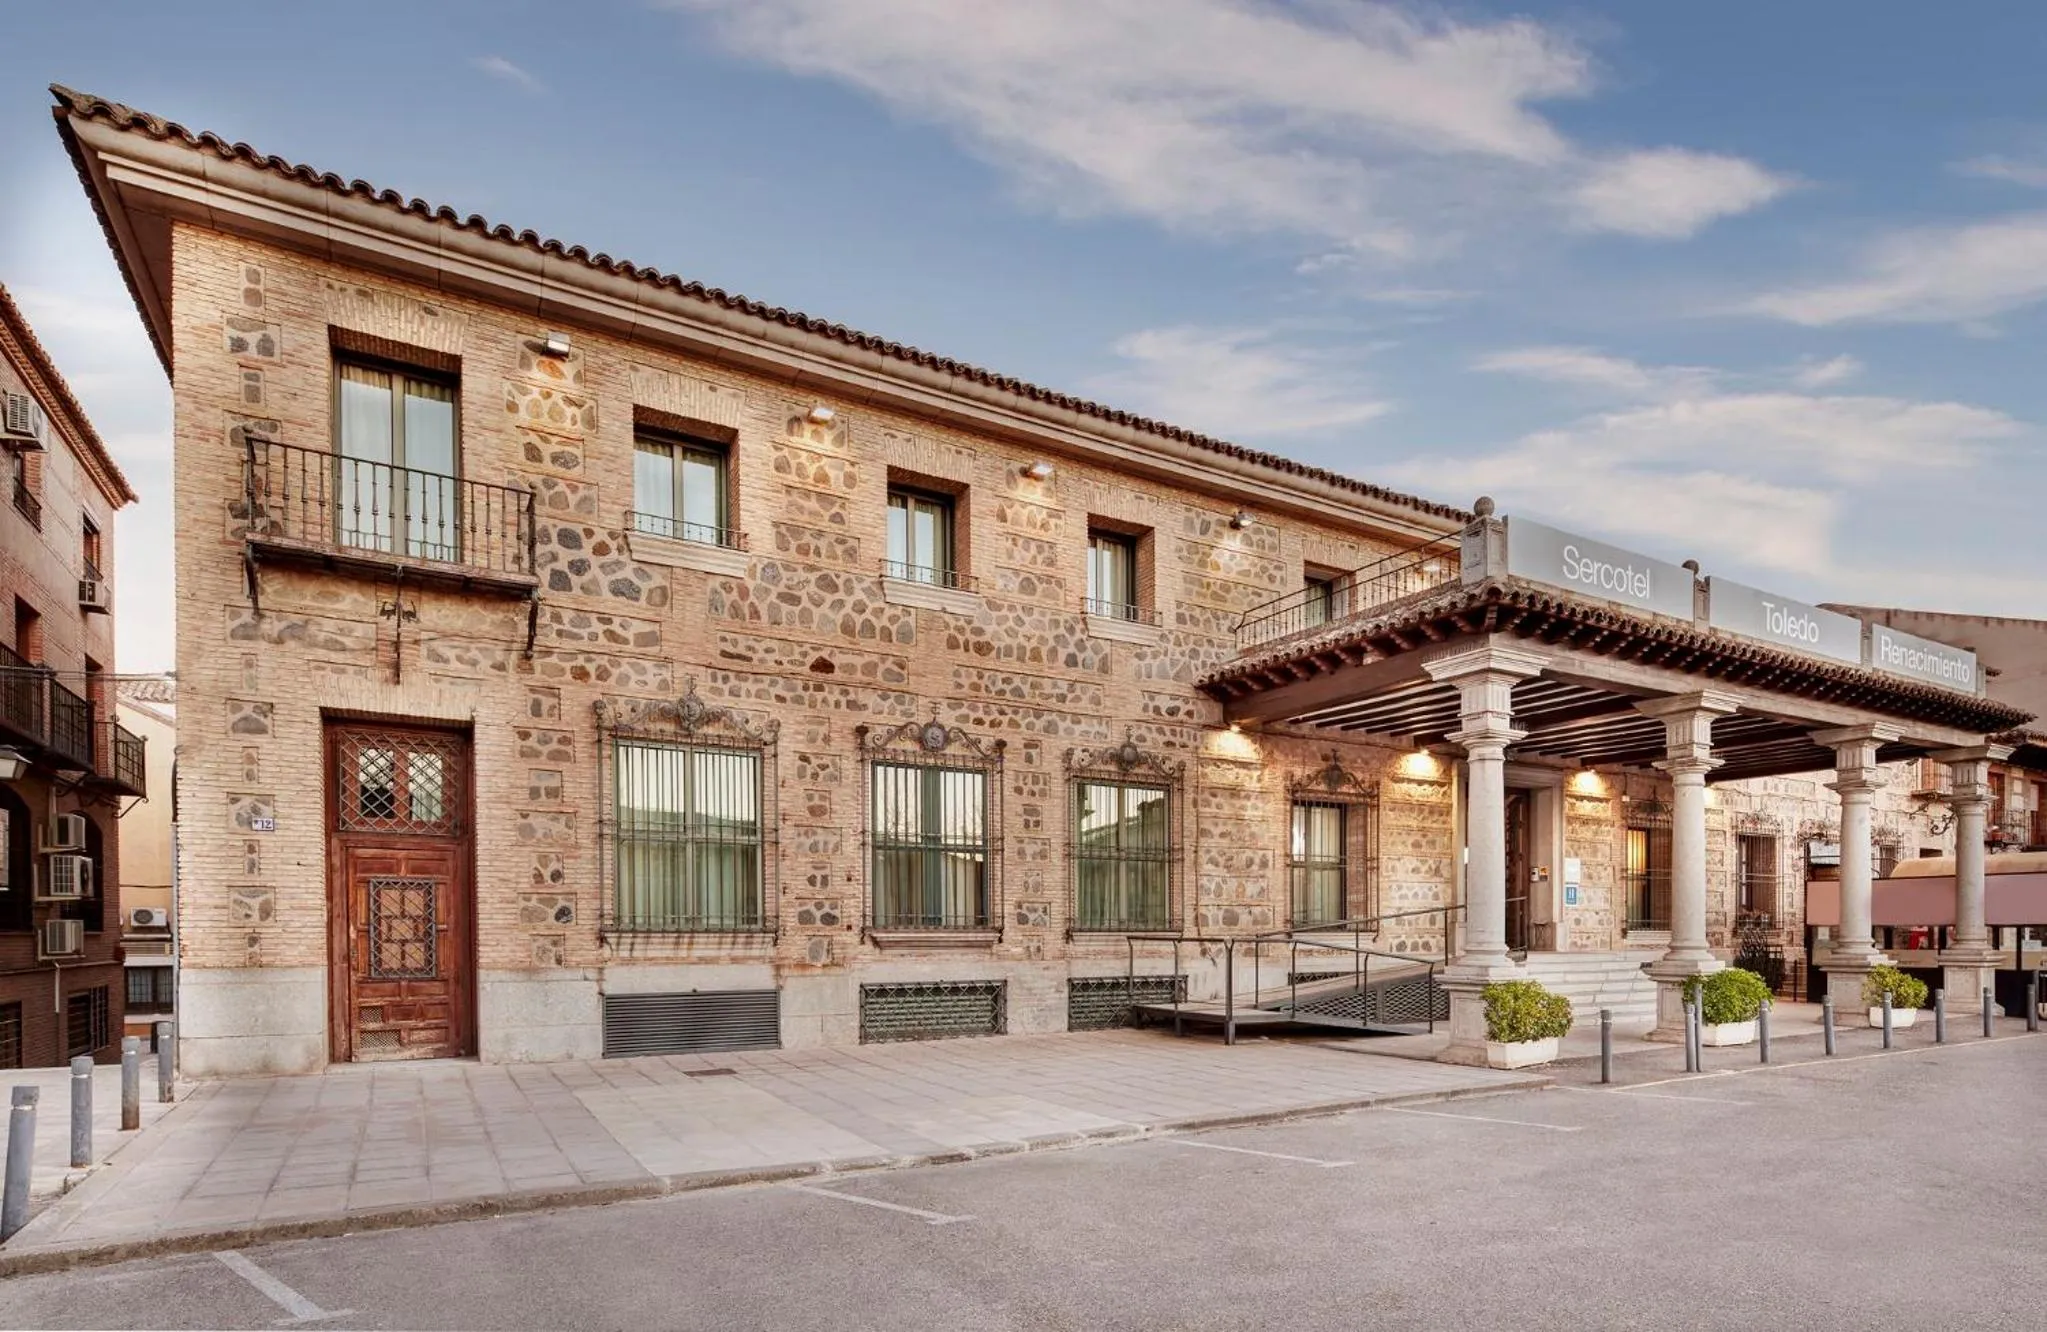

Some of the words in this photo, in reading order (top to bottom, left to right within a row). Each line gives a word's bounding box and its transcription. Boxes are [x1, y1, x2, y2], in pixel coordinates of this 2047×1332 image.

[1562, 545, 1650, 599] Sercotel
[1761, 600, 1819, 643] Toledo
[1880, 635, 1970, 683] Renacimiento
